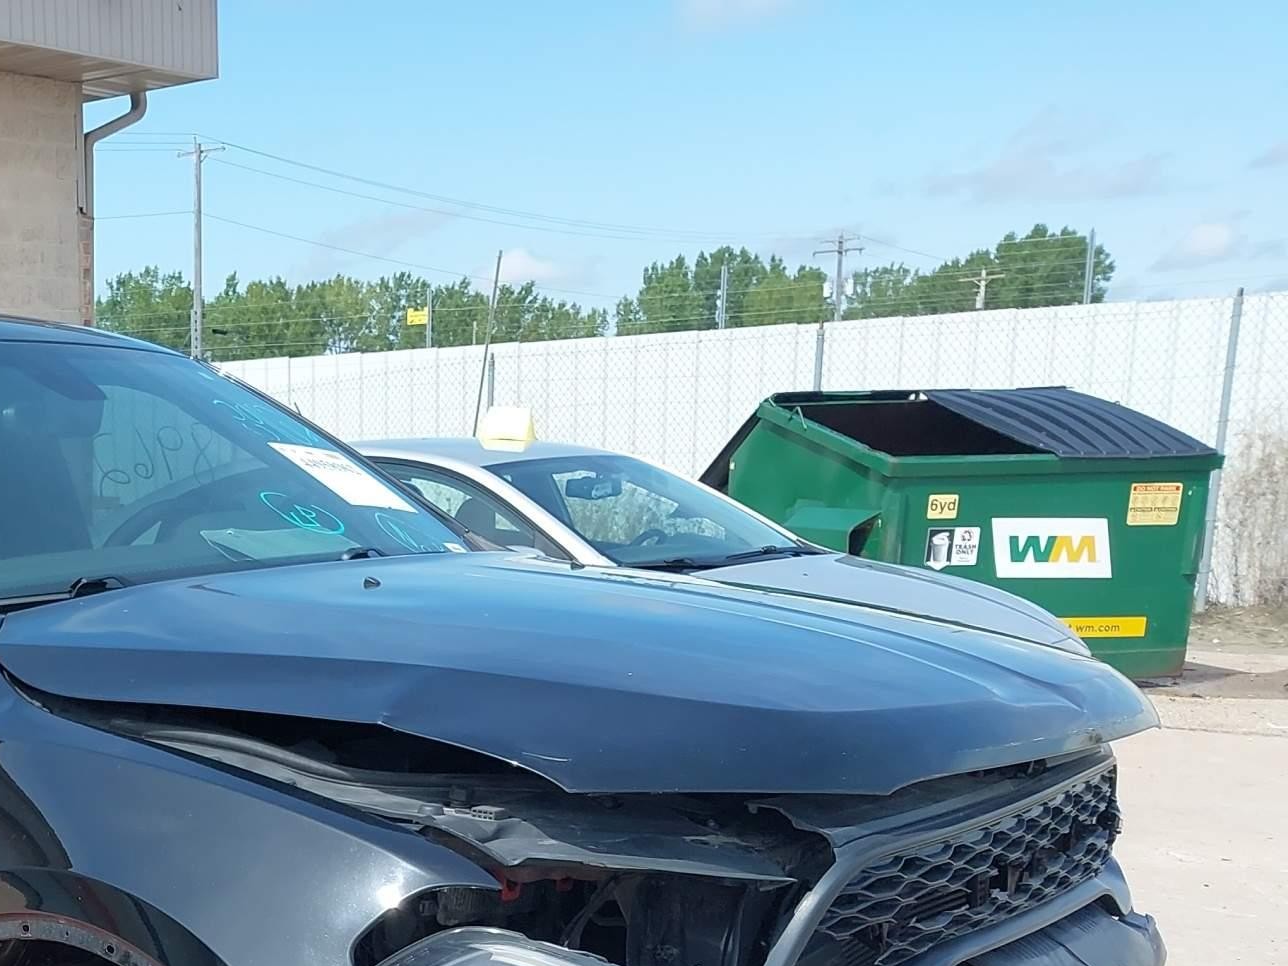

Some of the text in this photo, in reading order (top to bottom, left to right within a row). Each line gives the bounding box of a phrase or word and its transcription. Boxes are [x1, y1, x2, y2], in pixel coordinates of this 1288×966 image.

[930, 498, 957, 514] 6yd
[1009, 535, 1096, 563] WM
[1075, 624, 1120, 633] wm.com
